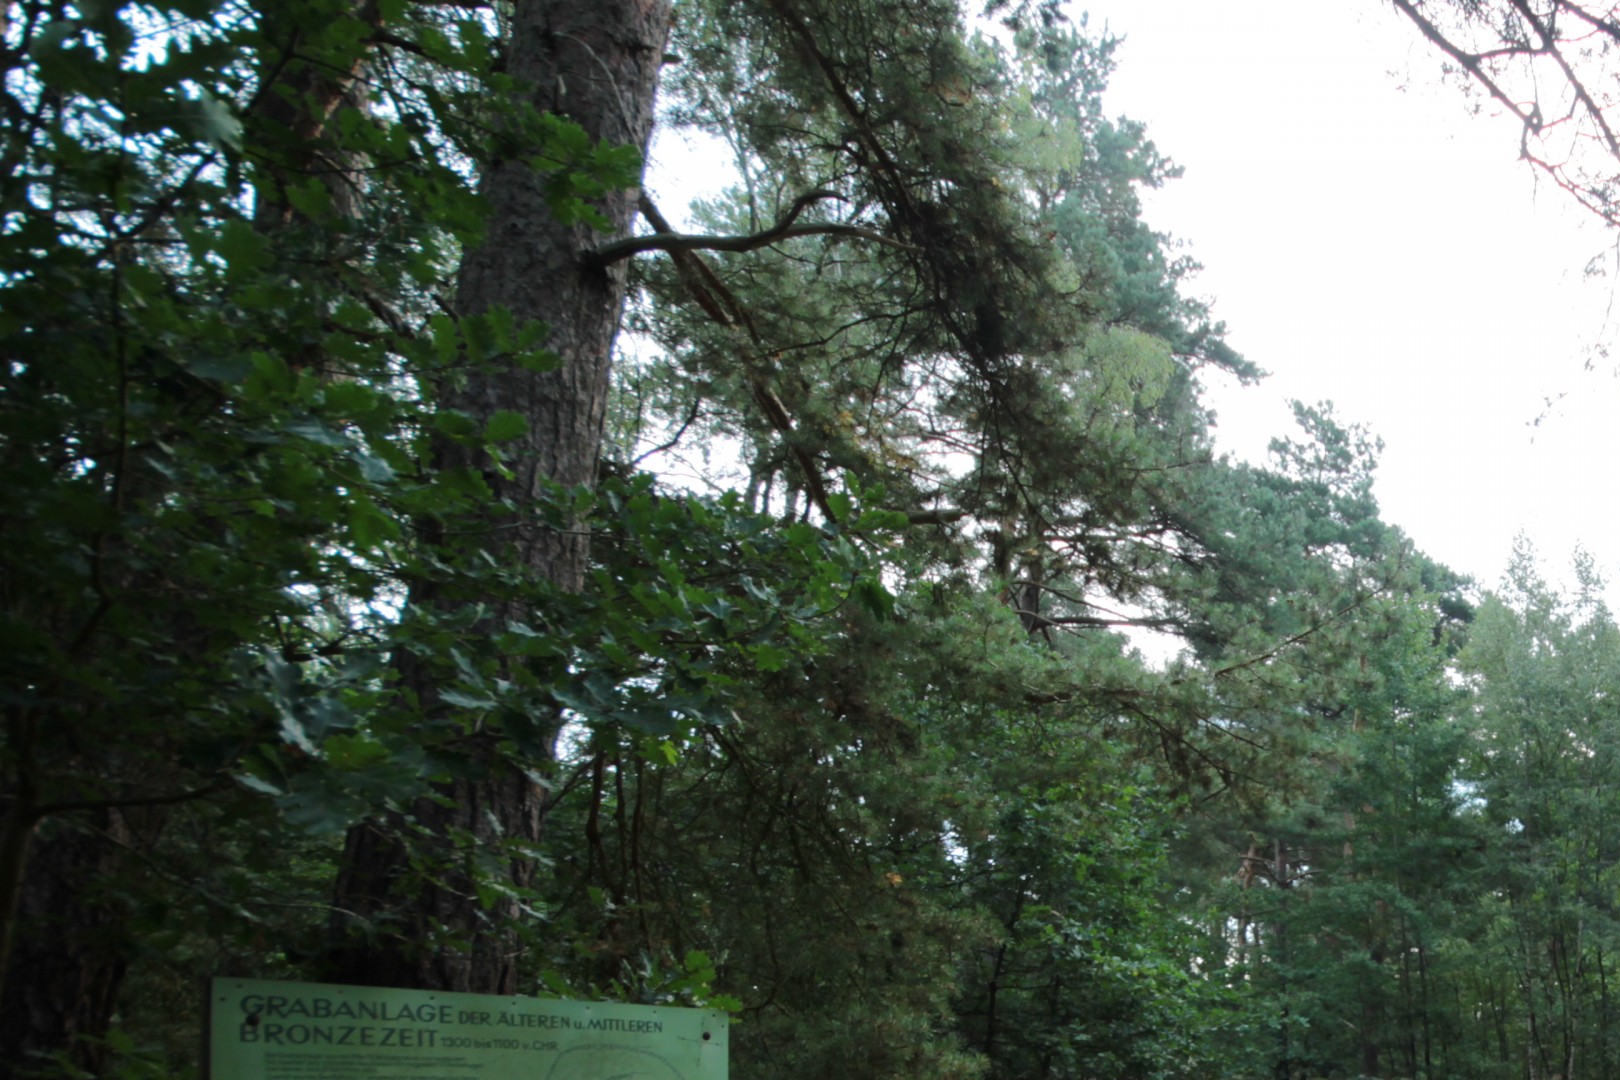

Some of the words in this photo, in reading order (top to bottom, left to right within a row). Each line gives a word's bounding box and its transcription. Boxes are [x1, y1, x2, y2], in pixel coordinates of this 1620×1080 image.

[240, 994, 453, 1023] GRABANLAGE
[459, 1011, 492, 1028] DER
[498, 1010, 570, 1030] ÄLTEREN
[587, 1018, 662, 1033] MITTLEREN
[240, 1024, 438, 1048] BRONZEZEIT
[474, 1037, 491, 1049] bis
